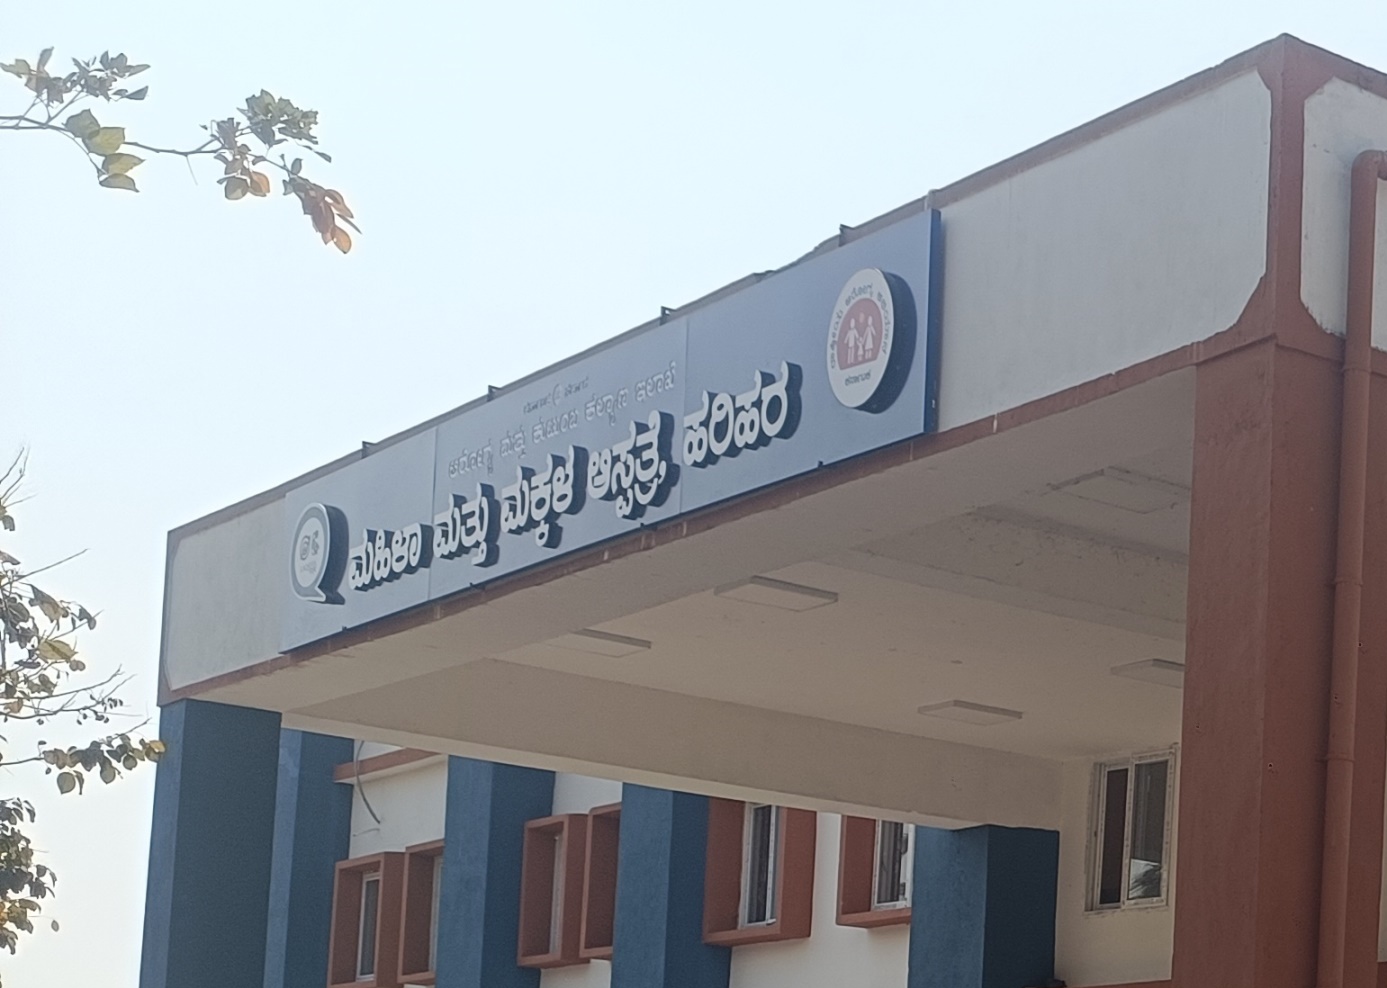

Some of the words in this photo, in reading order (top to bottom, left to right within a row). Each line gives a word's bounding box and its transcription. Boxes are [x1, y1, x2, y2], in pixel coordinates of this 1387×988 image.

[349, 523, 422, 589] ಮಹಿಳಾ
[433, 482, 489, 565] ಮತ್ತು
[501, 445, 574, 546] ಮಕ್ಕಳ
[587, 410, 666, 517] ಆಸ್ಪತ್ರೆ,
[683, 360, 789, 466] ಹರಿಹರ
